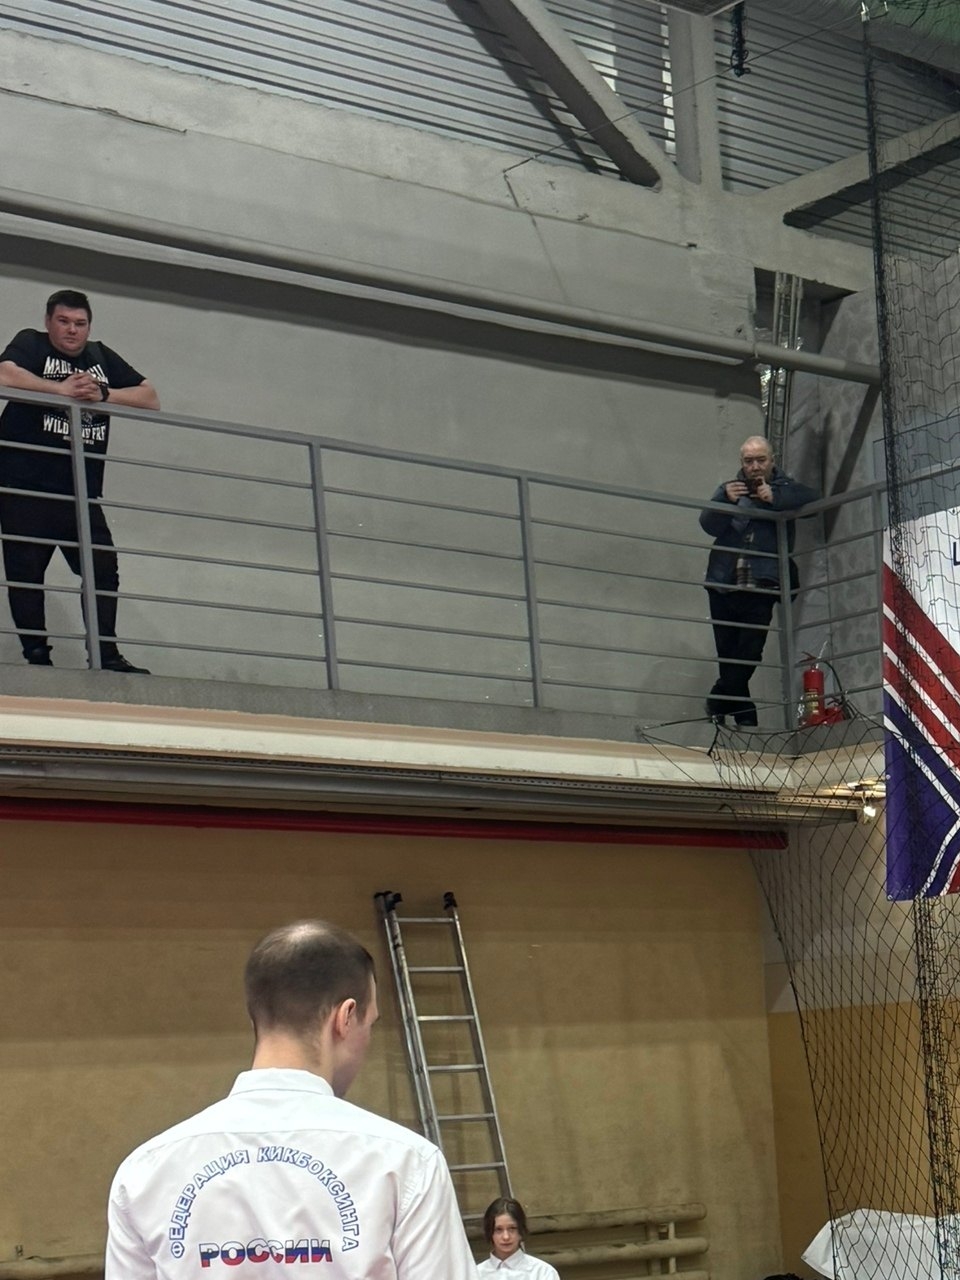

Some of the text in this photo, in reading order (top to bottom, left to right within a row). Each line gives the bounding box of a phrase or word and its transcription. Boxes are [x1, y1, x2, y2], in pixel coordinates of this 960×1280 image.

[43, 414, 69, 435] WILD
[169, 1145, 361, 1259] ФЕДЕРАЦИЯ КИКБОКСИНГА
[199, 1238, 333, 1268] РОССИИ
